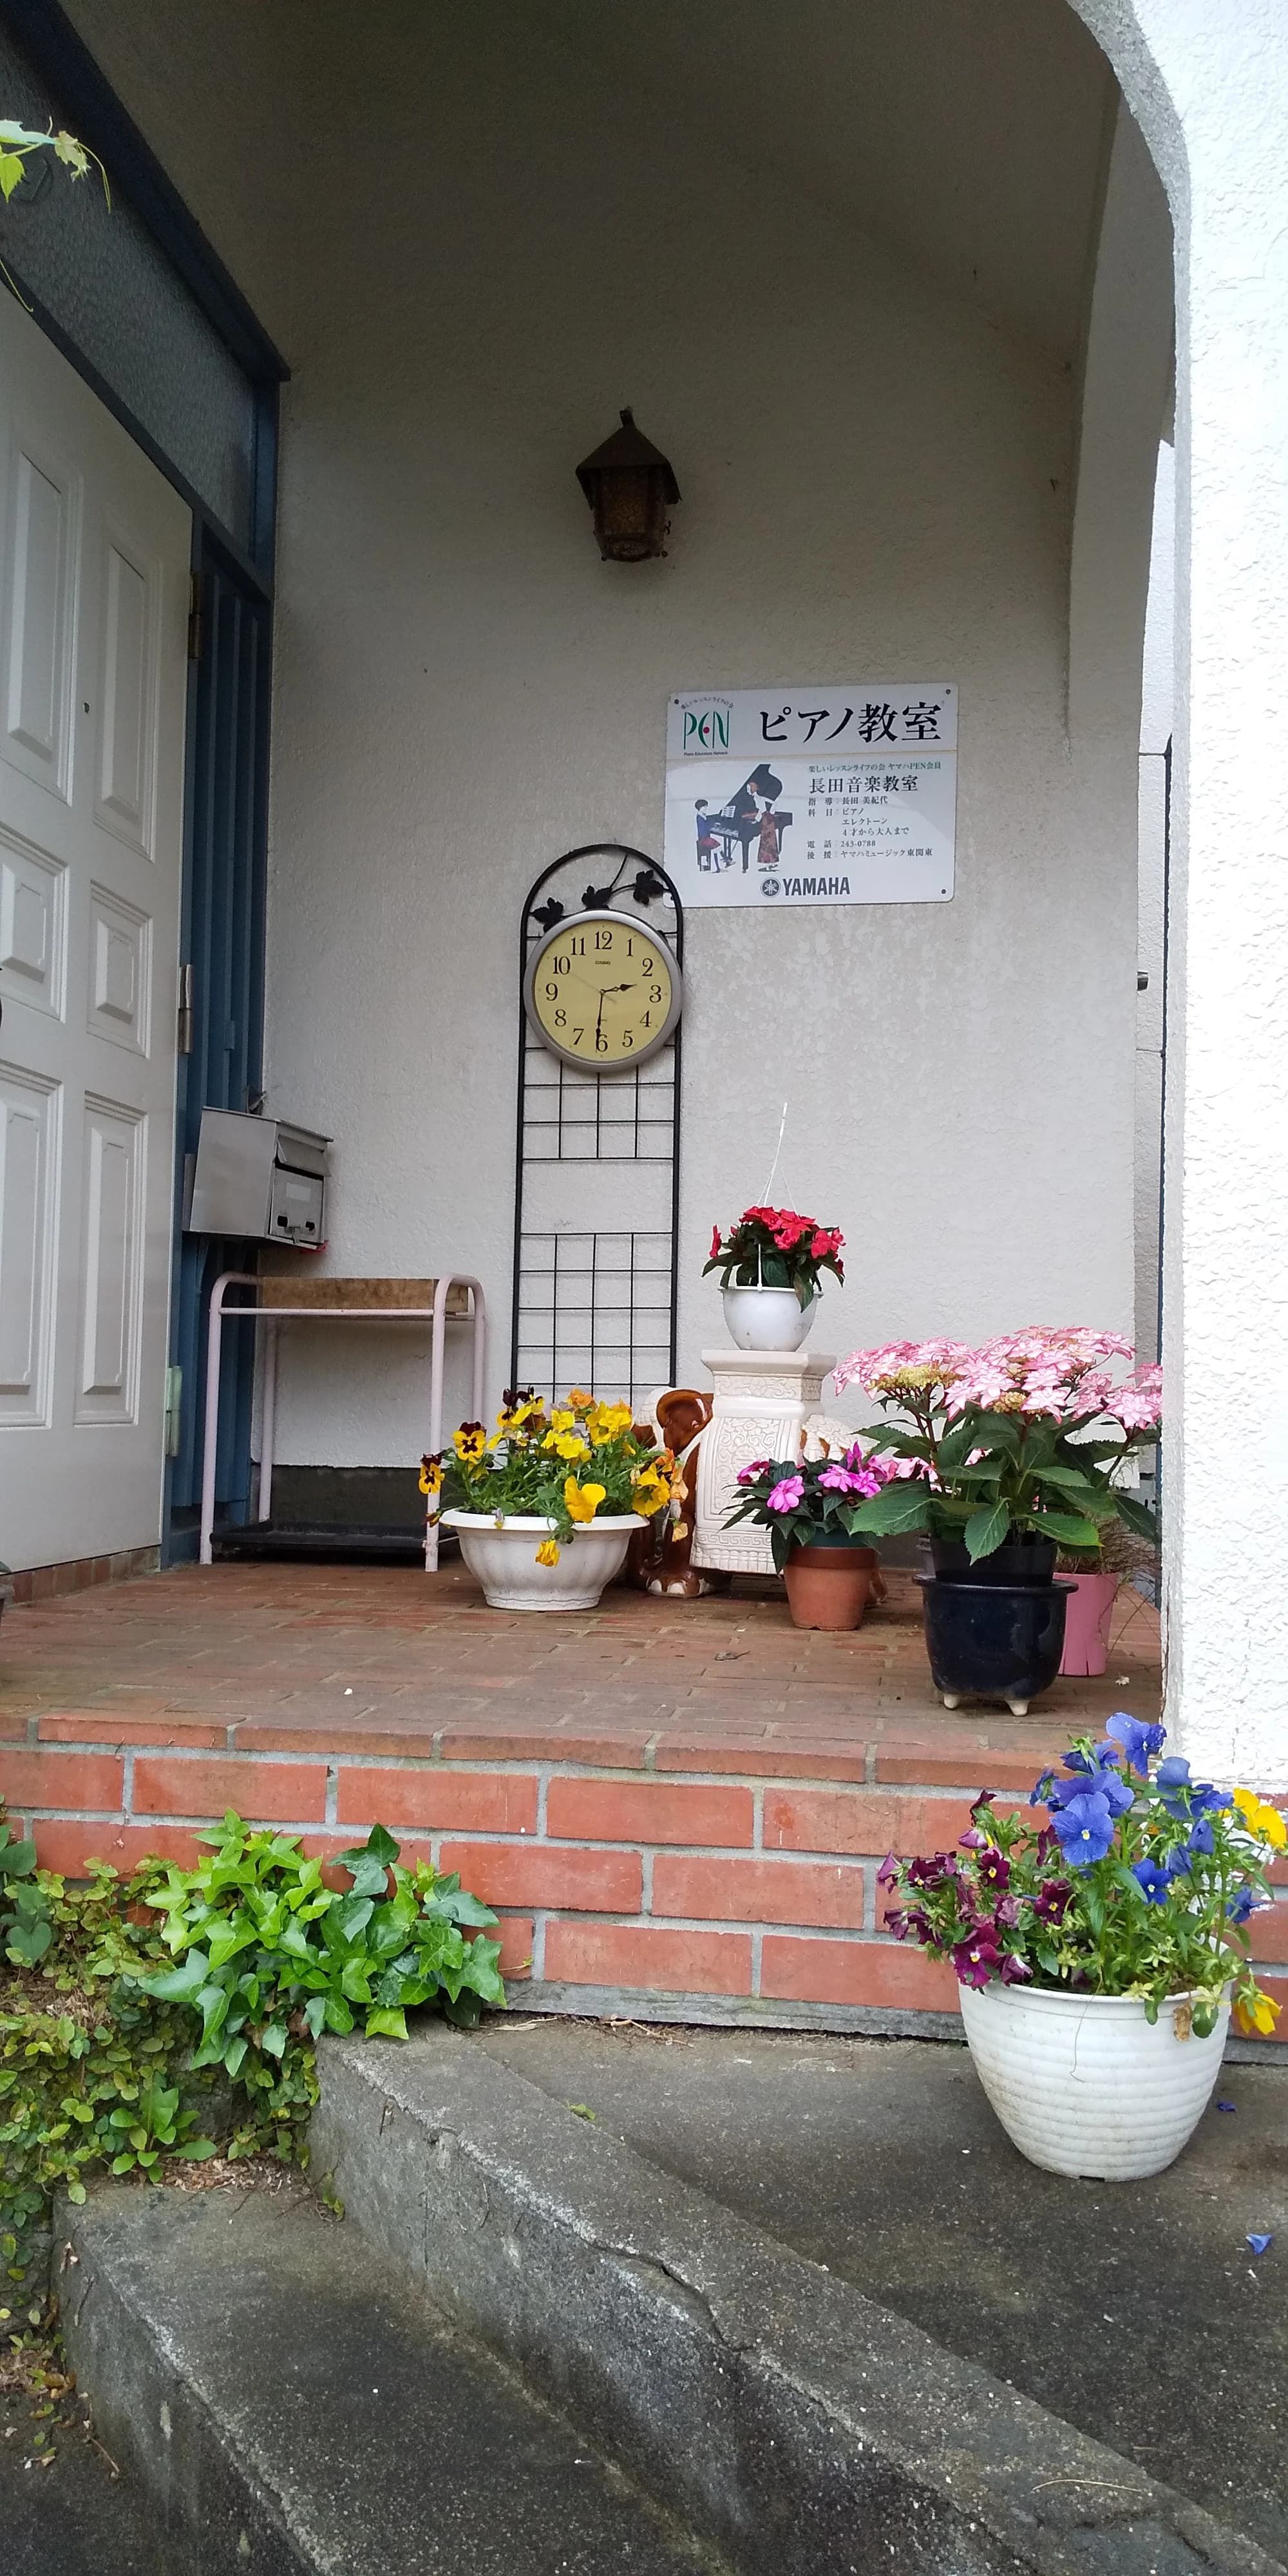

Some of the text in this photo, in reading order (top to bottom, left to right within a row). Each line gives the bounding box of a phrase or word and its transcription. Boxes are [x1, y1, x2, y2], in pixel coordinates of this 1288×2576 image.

[684, 710, 729, 750] PEN
[760, 701, 942, 743] ピアノ教室
[809, 775, 918, 793] 長田音楽教室
[842, 817, 888, 826] エレクトーン
[782, 877, 850, 896] YAMAHA
[571, 938, 586, 956] 11
[594, 931, 612, 950] 12
[627, 938, 634, 956] 1
[552, 956, 571, 975] 10
[641, 958, 653, 977] 2
[545, 983, 558, 1001] 9
[649, 985, 661, 1003] 3
[554, 1009, 567, 1027] 8
[639, 1010, 652, 1027] 4
[573, 1028, 585, 1045] 7
[596, 1034, 608, 1052] 6
[622, 1030, 633, 1047] 5
